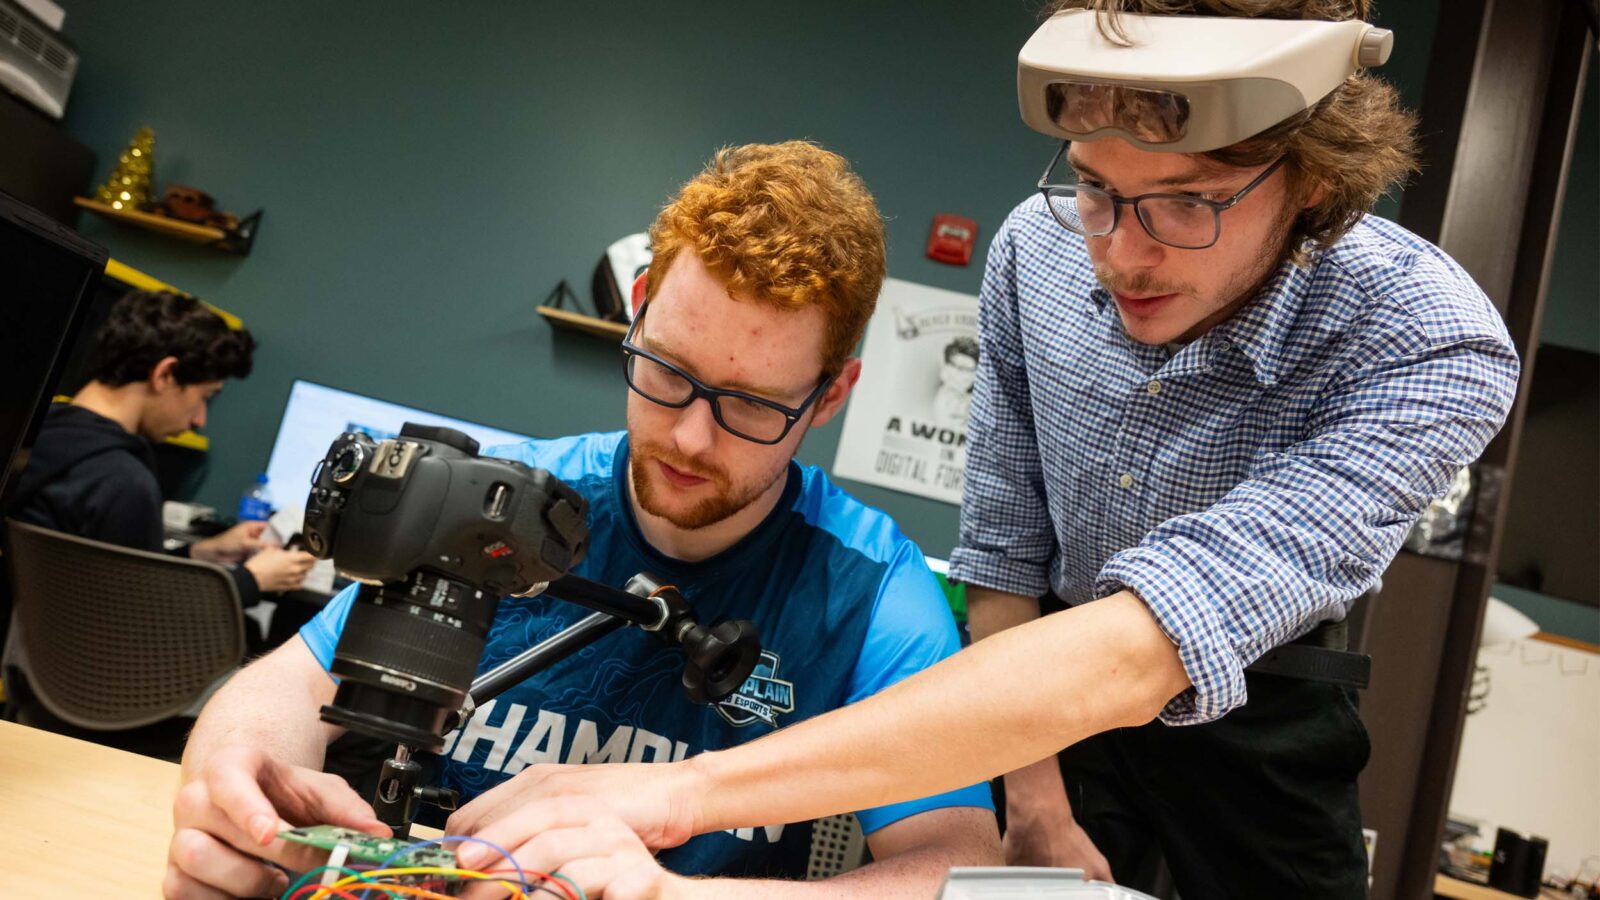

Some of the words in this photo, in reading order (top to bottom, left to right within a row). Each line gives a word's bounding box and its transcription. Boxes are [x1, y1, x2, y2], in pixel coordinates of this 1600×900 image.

[887, 416, 901, 432] A
[875, 450, 928, 484] DIGITAL
[735, 696, 769, 716] ESPORTS
